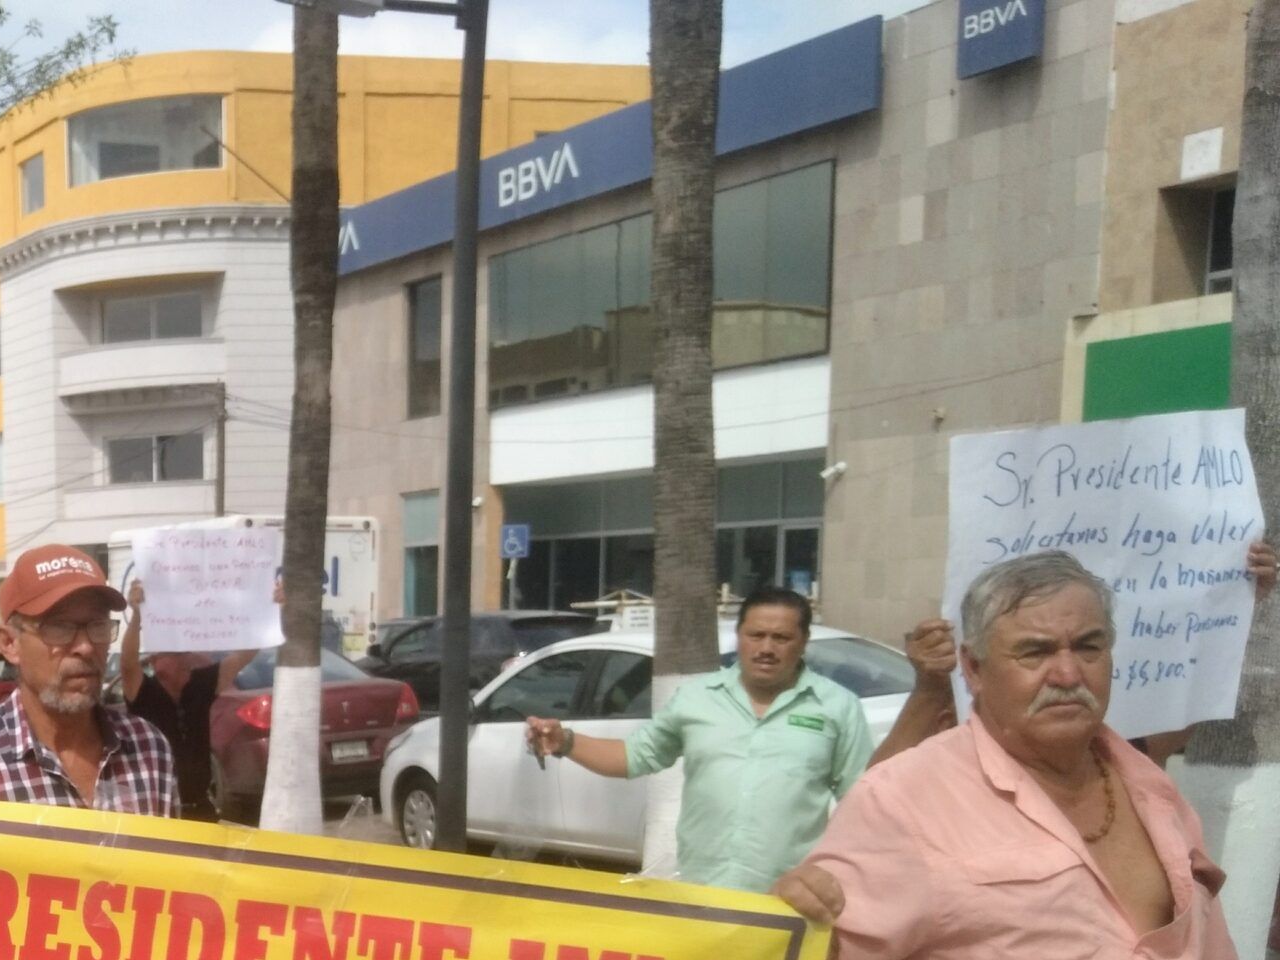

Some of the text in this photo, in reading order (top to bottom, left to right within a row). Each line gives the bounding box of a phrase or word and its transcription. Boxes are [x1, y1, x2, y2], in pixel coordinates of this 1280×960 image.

[963, 0, 1027, 39] BBVA
[498, 142, 580, 208] BBVA
[982, 436, 1244, 509] Sr. Presidente AMLO
[1121, 512, 1176, 556] haga
[35, 556, 94, 575] morena
[1149, 560, 1168, 591] la
[1130, 606, 1177, 640] haber
